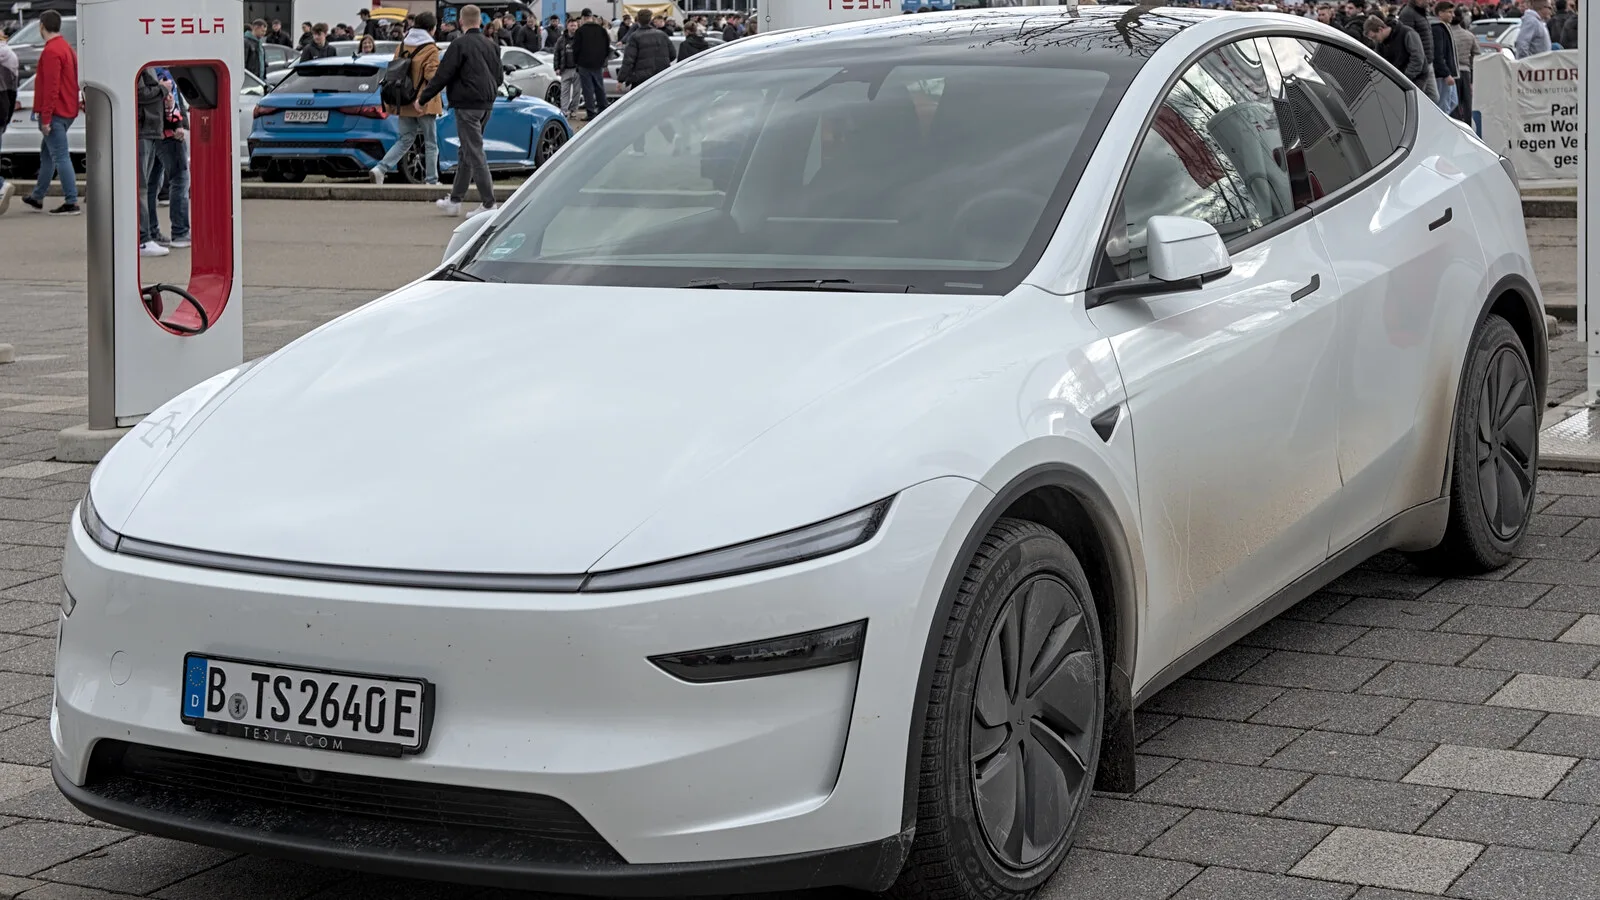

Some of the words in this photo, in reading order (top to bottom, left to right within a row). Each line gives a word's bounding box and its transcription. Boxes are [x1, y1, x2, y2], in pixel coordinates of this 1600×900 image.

[138, 18, 225, 34] TESLA
[1517, 68, 1578, 82] MOTOR
[1523, 122, 1545, 133] am
[207, 666, 226, 713] B
[191, 694, 199, 707] D
[244, 727, 343, 750] TESLA.COM
